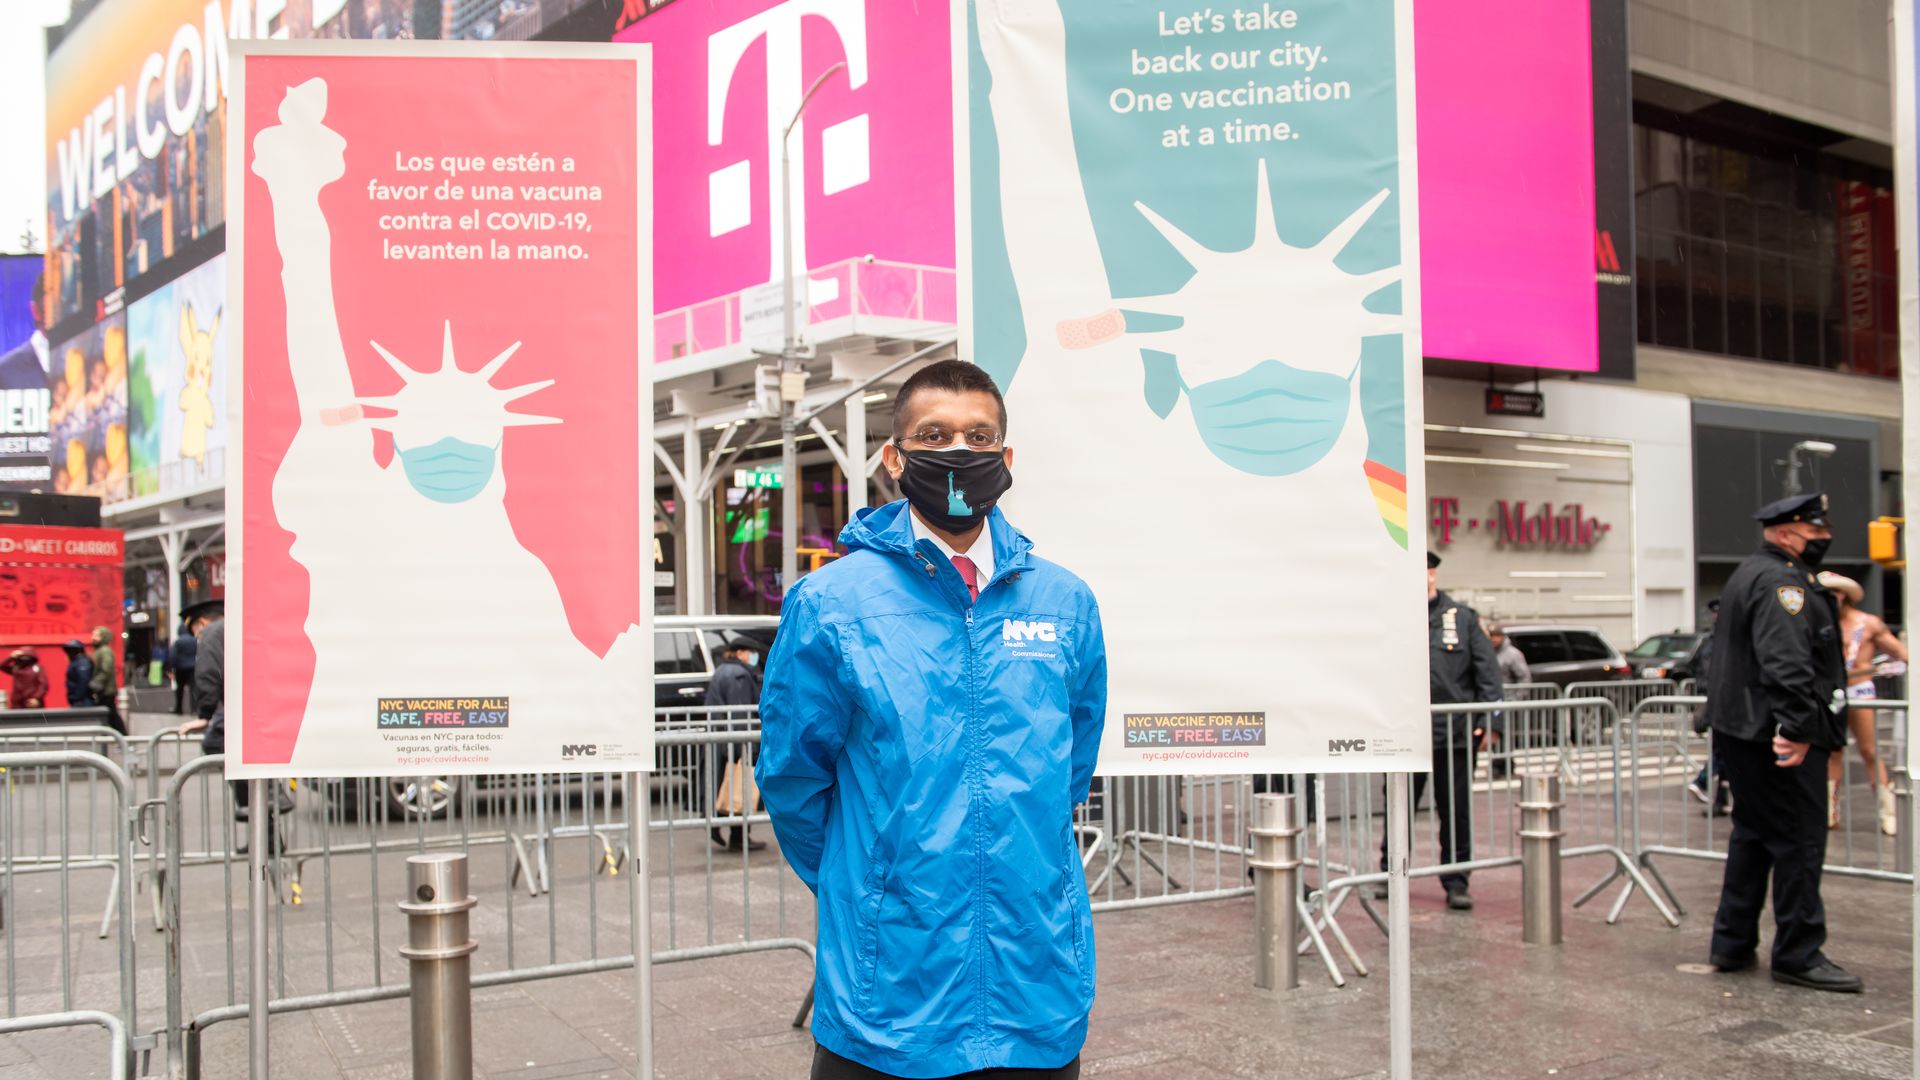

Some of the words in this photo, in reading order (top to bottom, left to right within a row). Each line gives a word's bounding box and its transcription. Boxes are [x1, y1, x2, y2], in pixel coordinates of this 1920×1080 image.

[1158, 8, 1225, 36] Let’s
[1232, 3, 1298, 31] take
[1131, 45, 1202, 75] back
[1210, 50, 1261, 71] our
[1268, 40, 1328, 72] city.
[1108, 87, 1173, 114] One
[1181, 76, 1351, 110] vaccination
[1161, 124, 1190, 148] at
[1198, 127, 1215, 146] a
[1223, 118, 1300, 145] time.
[395, 151, 435, 172] Los
[440, 156, 486, 177] que
[492, 152, 555, 173] estén
[561, 156, 576, 173] a
[367, 179, 428, 201] favor
[434, 179, 465, 201] de
[471, 185, 514, 201] una
[520, 185, 602, 201] vacuna
[378, 211, 453, 230] contra
[459, 208, 480, 230] el
[486, 211, 592, 233] COVID-19,
[383, 238, 484, 260] levanten
[490, 238, 511, 260] la
[517, 243, 590, 260] mano.
[759, 472, 773, 488] 46
[24, 538, 62, 555] SWEET
[64, 540, 119, 557] CHURROS
[1002, 618, 1057, 642] NYC
[1012, 650, 1057, 659] Commissioner
[380, 700, 404, 711] NYC
[406, 699, 455, 711] VACCINE
[457, 699, 480, 710] FOR
[482, 699, 508, 709] ALL:
[380, 712, 421, 726] SAFE,
[424, 712, 465, 725] FREE,
[468, 711, 507, 724] EASY
[1127, 716, 1152, 727] NYC
[1155, 716, 1206, 727] VACCINE
[1209, 715, 1233, 726] FOR
[1236, 715, 1264, 726] ALL:
[383, 733, 419, 741] Vacunas
[433, 733, 454, 741] NYC
[455, 734, 475, 742] para
[476, 732, 504, 741] todos:
[1127, 730, 1171, 744] SAFE,
[1175, 729, 1218, 743] FREE,
[1222, 728, 1262, 741] EASY
[396, 745, 432, 754] seguras,
[434, 744, 460, 754] gratis,
[562, 744, 597, 756] NYC
[1328, 739, 1366, 752] NYC
[398, 755, 489, 765] nyc.gov/covidvaccine
[1142, 749, 1250, 761] nyc.gov/covidvaccine
